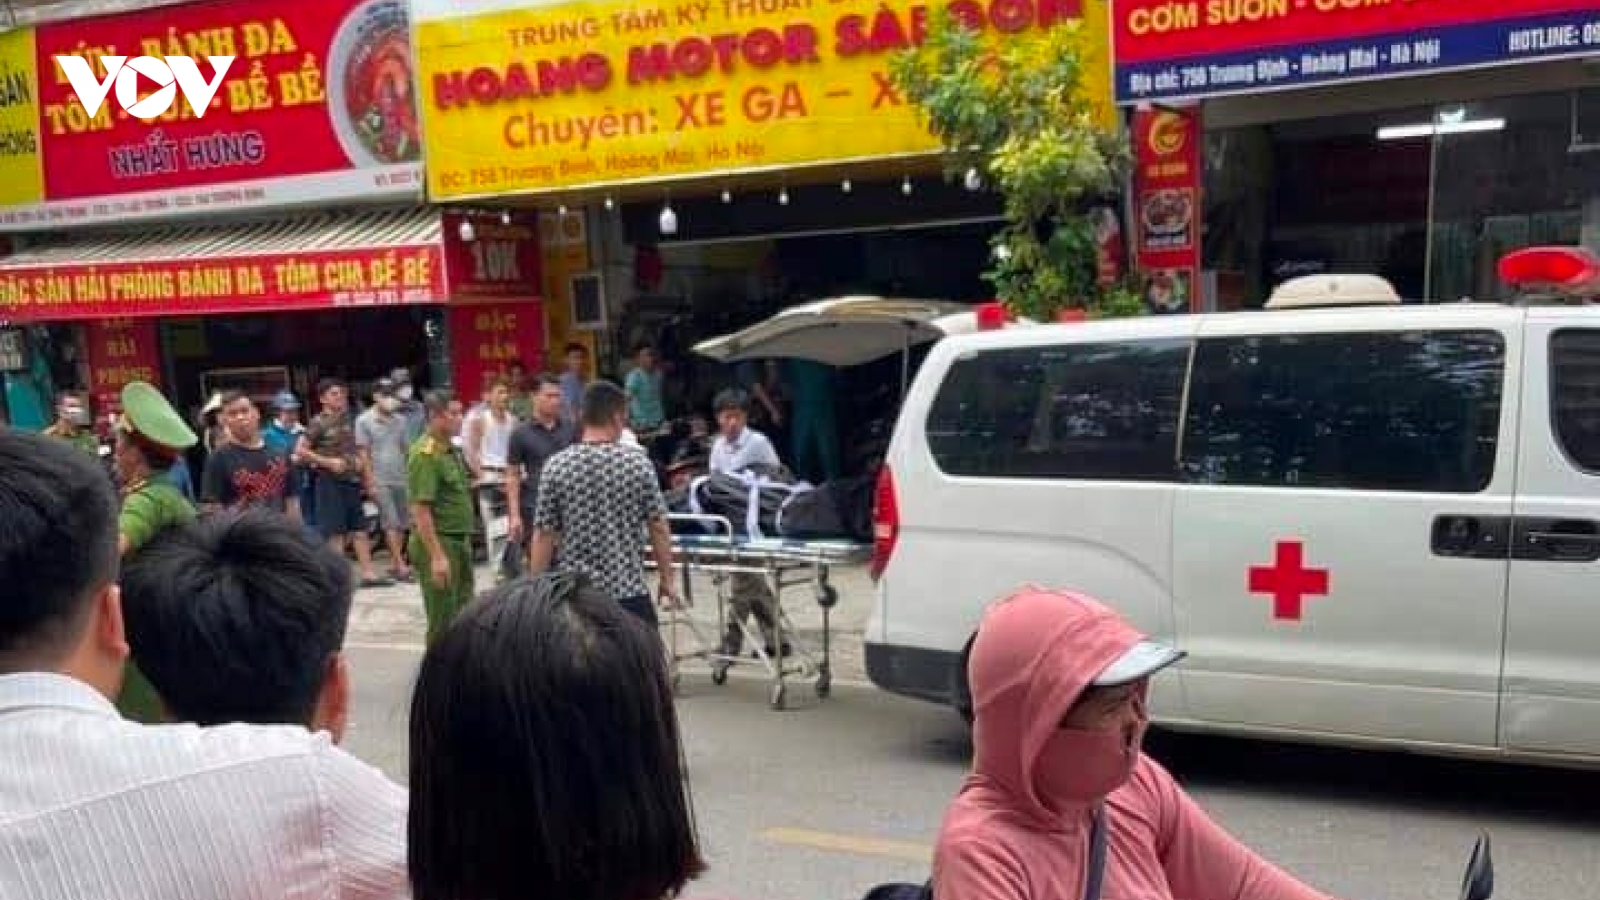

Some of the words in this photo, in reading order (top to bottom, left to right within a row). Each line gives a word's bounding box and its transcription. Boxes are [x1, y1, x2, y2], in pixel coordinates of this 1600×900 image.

[508, 19, 598, 47] TRUNG
[1128, 2, 1199, 36] CƠM
[627, 25, 820, 86] MOTOR
[1509, 26, 1579, 51] HOTLINE:
[675, 91, 726, 132] XE
[741, 80, 808, 124] GA
